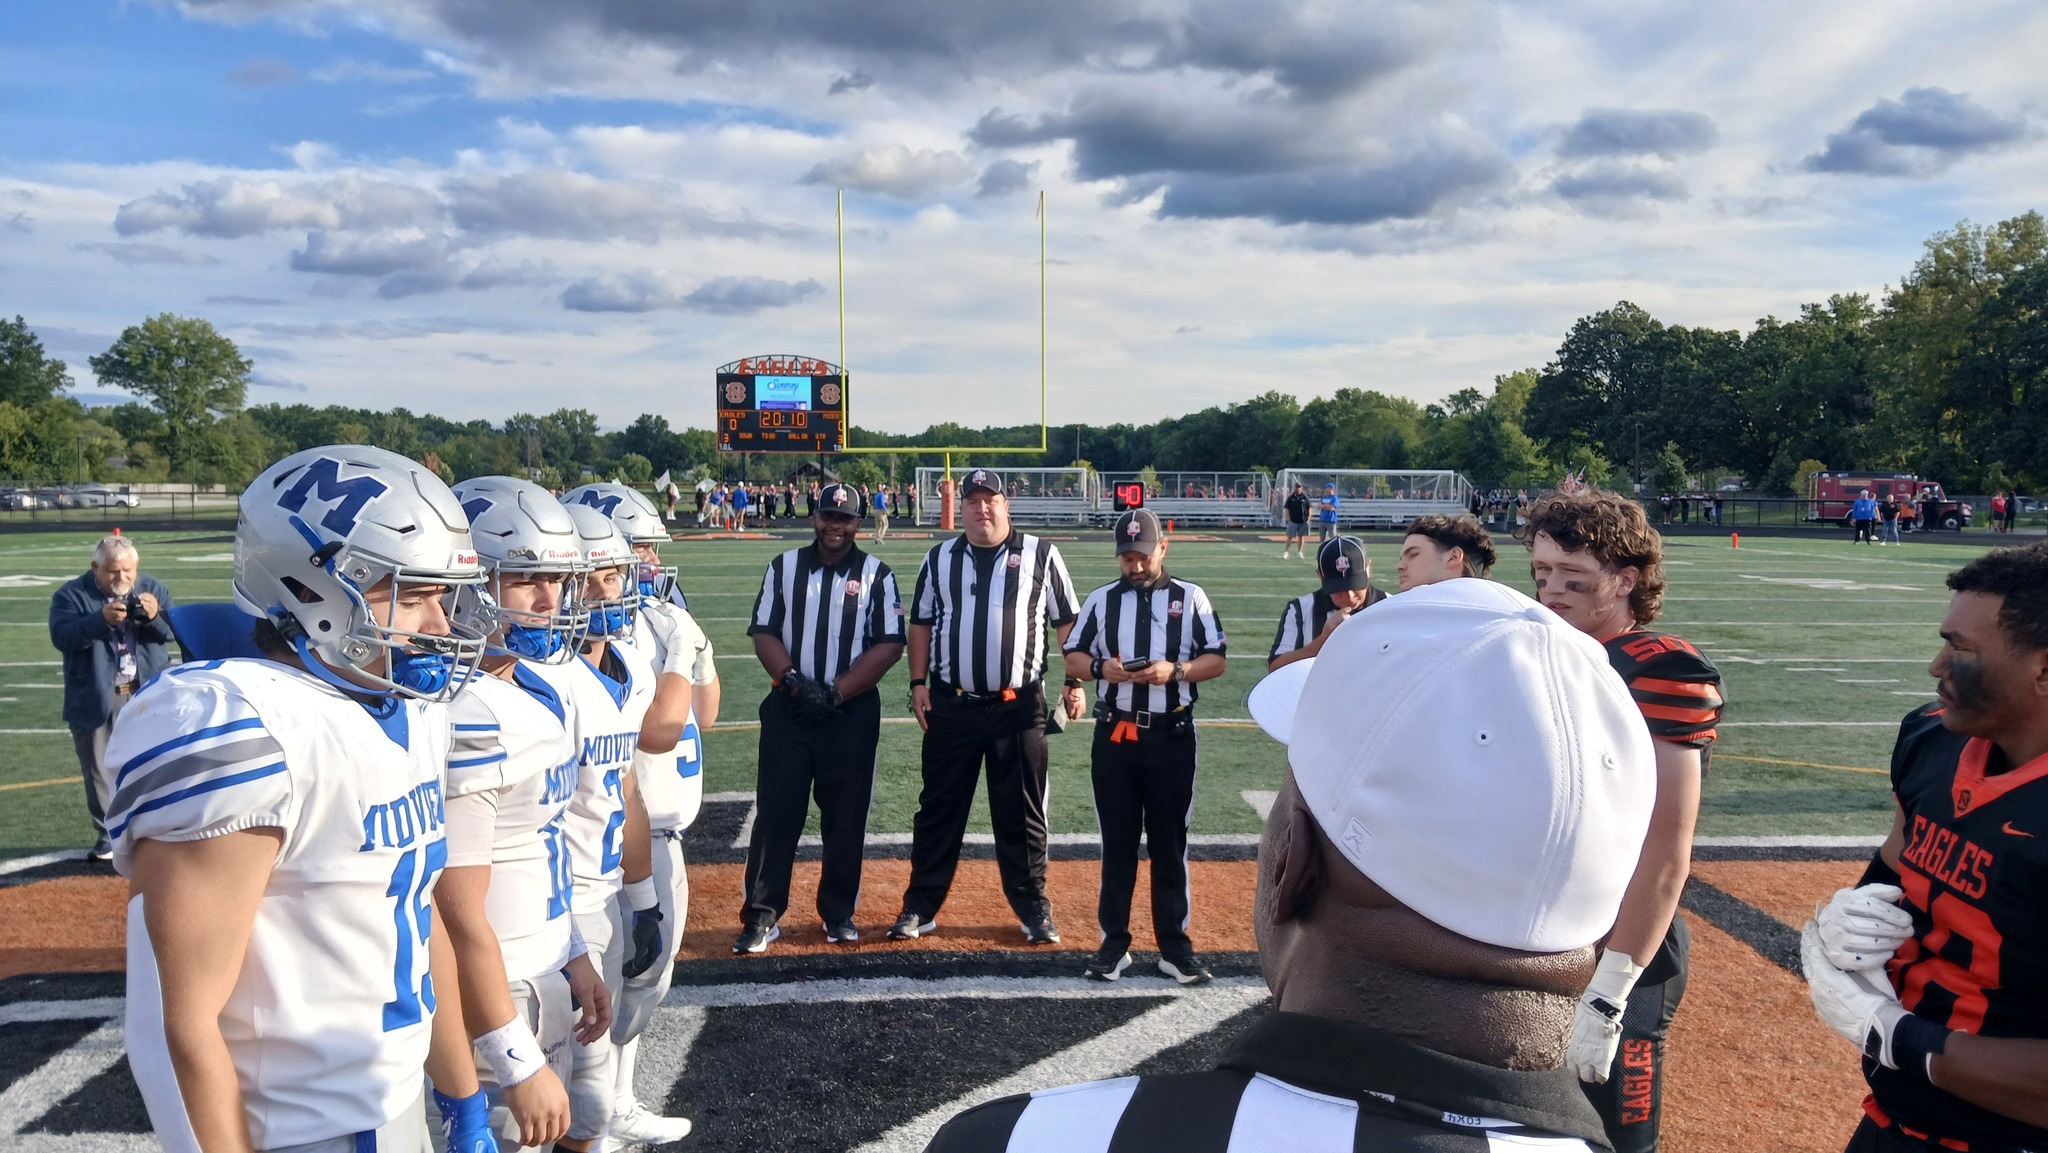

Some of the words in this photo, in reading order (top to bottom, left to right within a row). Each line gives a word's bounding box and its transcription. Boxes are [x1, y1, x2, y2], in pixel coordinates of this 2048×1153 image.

[738, 358, 828, 376] EAGLES
[276, 456, 389, 538] M
[1117, 485, 1141, 505] 40
[1621, 636, 1699, 662] 50
[1903, 814, 1994, 900] EAGLES
[1622, 1039, 1652, 1125] EAGLES
